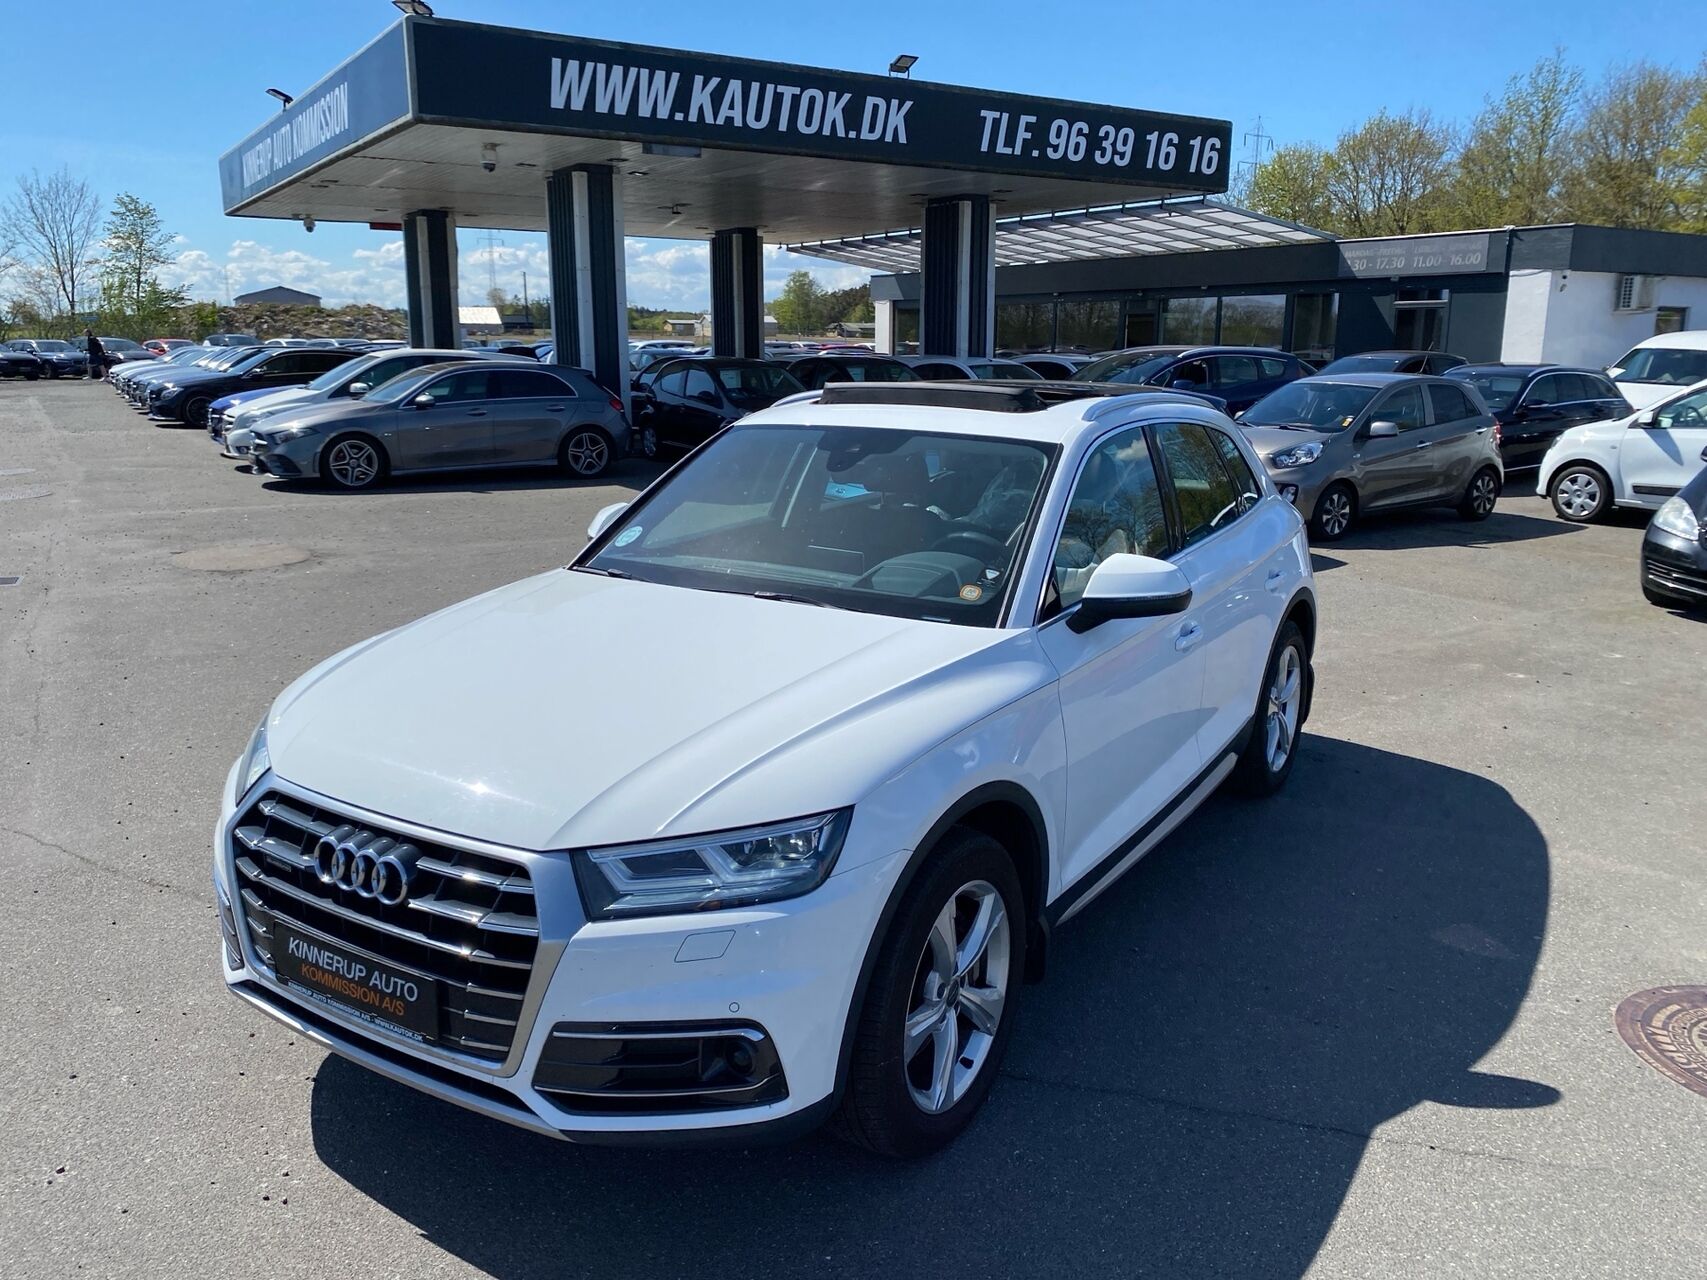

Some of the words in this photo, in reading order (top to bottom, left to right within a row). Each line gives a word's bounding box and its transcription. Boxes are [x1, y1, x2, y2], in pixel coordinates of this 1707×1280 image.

[273, 123, 292, 171] AUTO
[292, 81, 349, 160] KOMMISSION
[550, 57, 914, 144] WWW.KAUTOK.DK
[980, 109, 1039, 158] TLF.
[1046, 118, 1090, 162] 96
[1094, 124, 1135, 167] 39
[1145, 130, 1179, 171] 16
[1188, 135, 1221, 175] 16
[1346, 257, 1368, 272] 30
[1376, 256, 1405, 270] 17.30
[1413, 254, 1442, 268] 11.00
[1449, 251, 1481, 266] 16.00
[289, 937, 367, 982] KINNERUP
[369, 971, 418, 1002] AUTO
[301, 963, 381, 1007] KOMMISSION
[383, 996, 405, 1017] A/S
